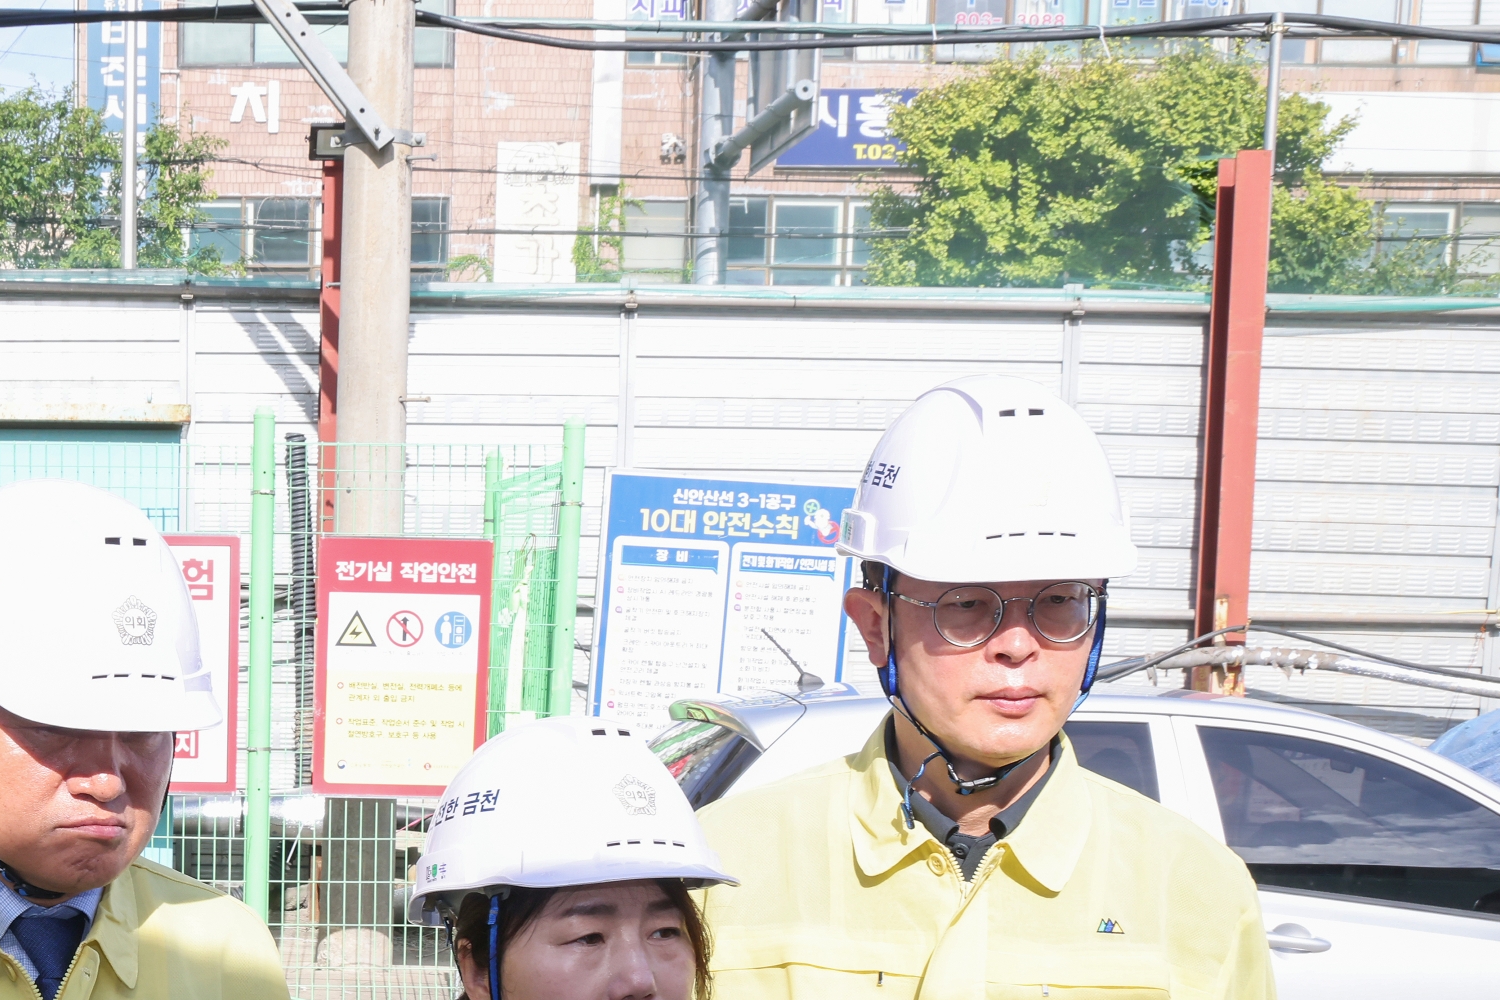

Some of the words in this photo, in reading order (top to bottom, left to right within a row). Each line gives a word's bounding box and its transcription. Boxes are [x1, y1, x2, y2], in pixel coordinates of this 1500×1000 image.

[872, 462, 901, 489] 금천
[672, 487, 735, 508] 신안산선
[737, 491, 797, 511] 3-1공구
[640, 508, 697, 534] 10대
[702, 510, 800, 540] 안전수칙
[334, 560, 393, 582] 전기실
[399, 561, 477, 584] 작업안전
[123, 615, 146, 631] 의회
[462, 788, 501, 817] 금천
[624, 790, 648, 802] 의회
